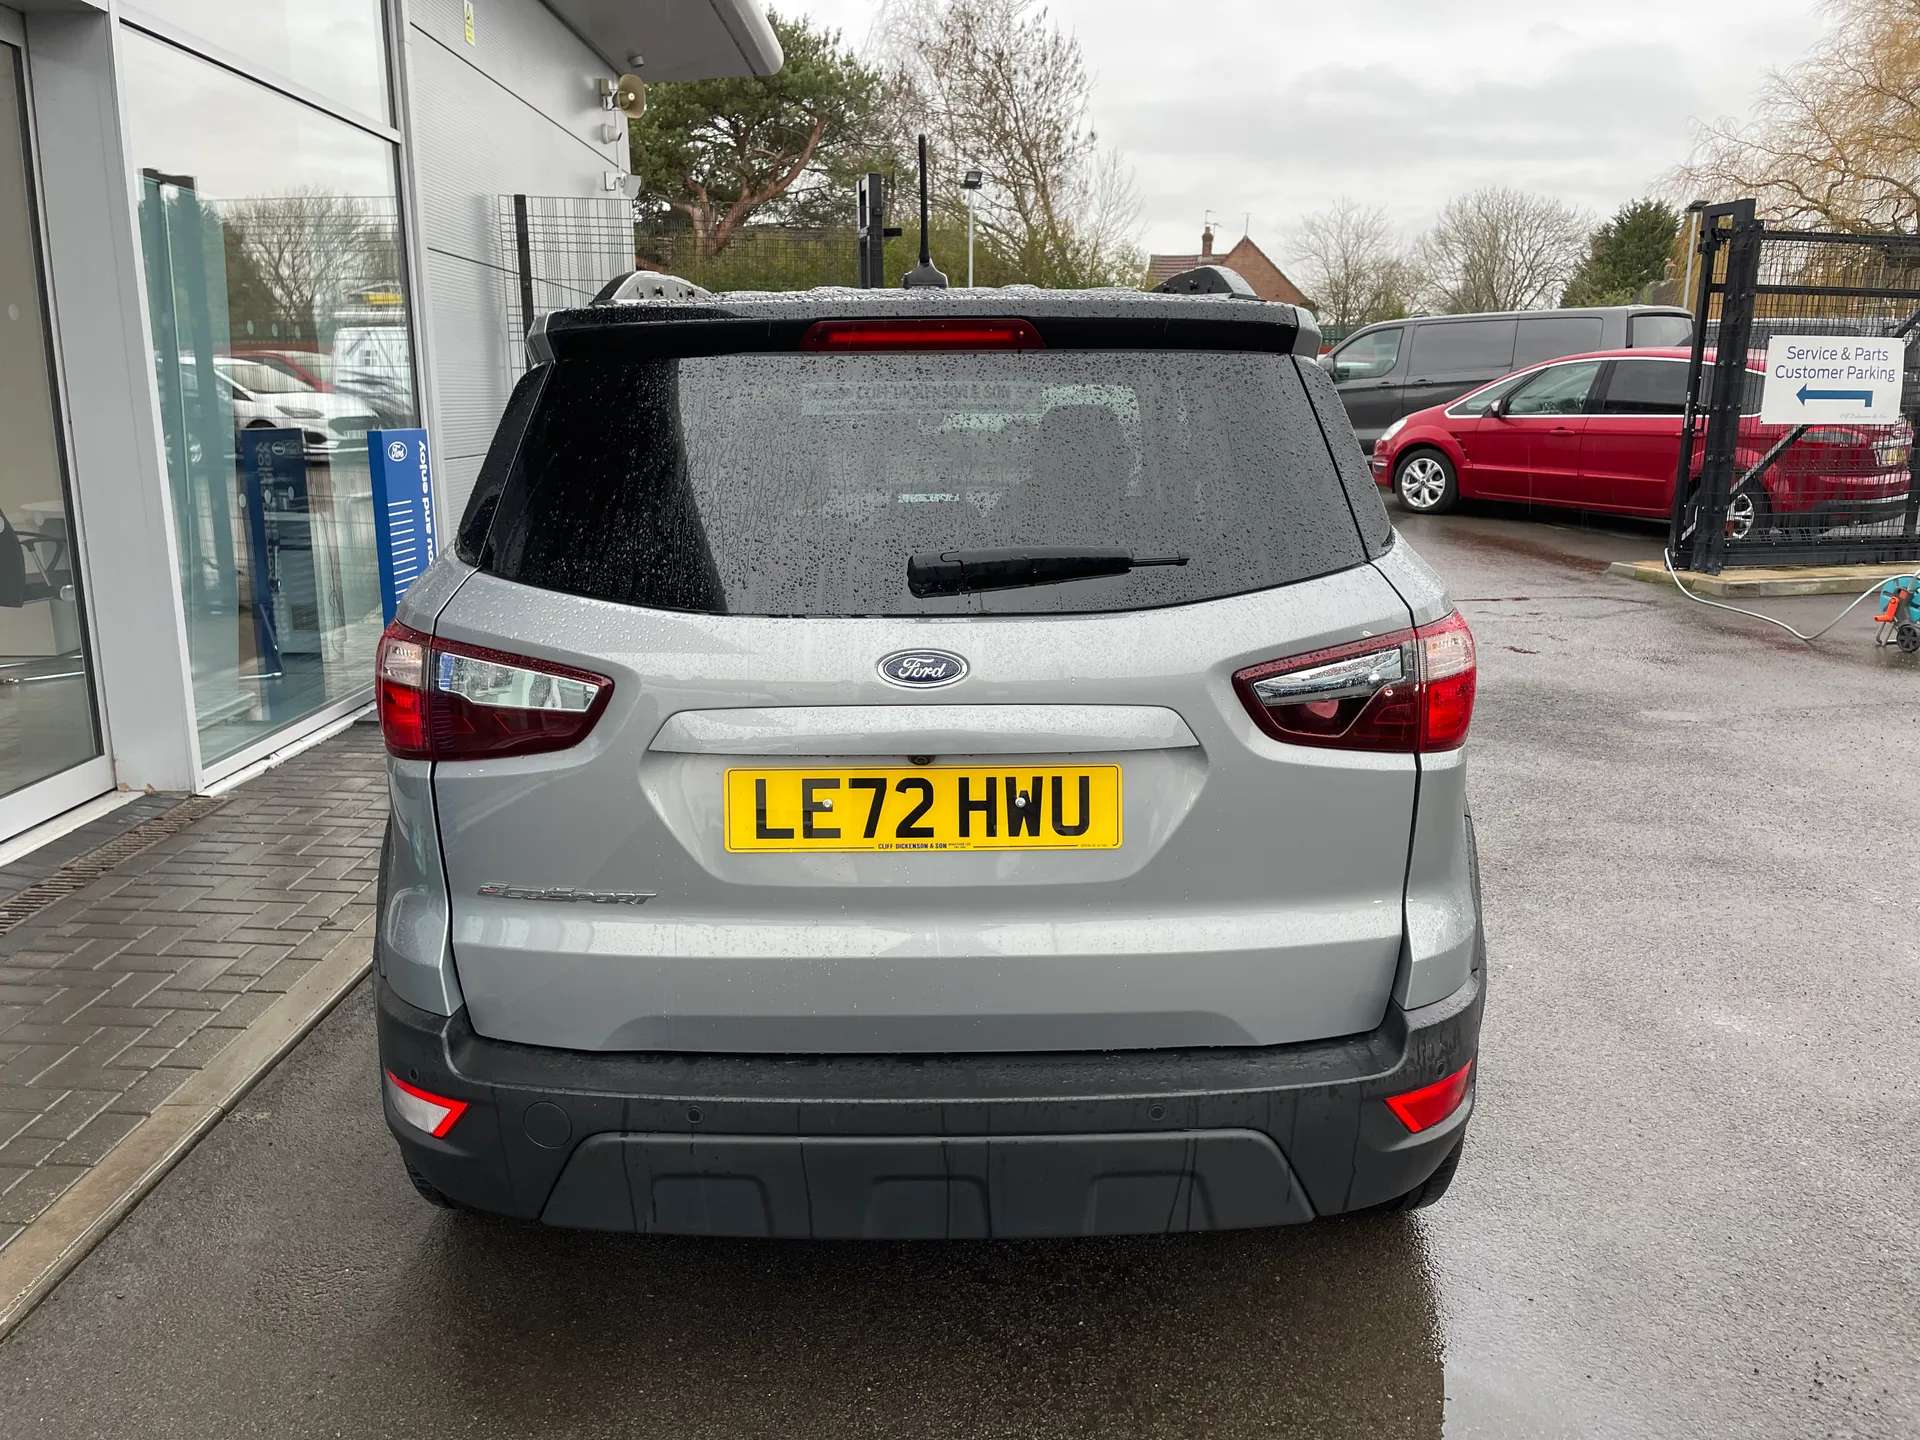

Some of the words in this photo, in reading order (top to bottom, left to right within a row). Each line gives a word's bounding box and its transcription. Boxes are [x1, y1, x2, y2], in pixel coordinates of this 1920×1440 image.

[1786, 345, 1838, 361] Service
[1840, 347, 1852, 361] &
[1854, 347, 1889, 362] Parts
[1775, 364, 1844, 380] Customer
[1846, 365, 1896, 382] Parking
[418, 440, 428, 494] enjoy
[422, 497, 432, 535] and
[427, 537, 436, 565] ou
[898, 657, 947, 678] Ford
[755, 777, 934, 840] LE72
[958, 775, 1090, 838] HWU
